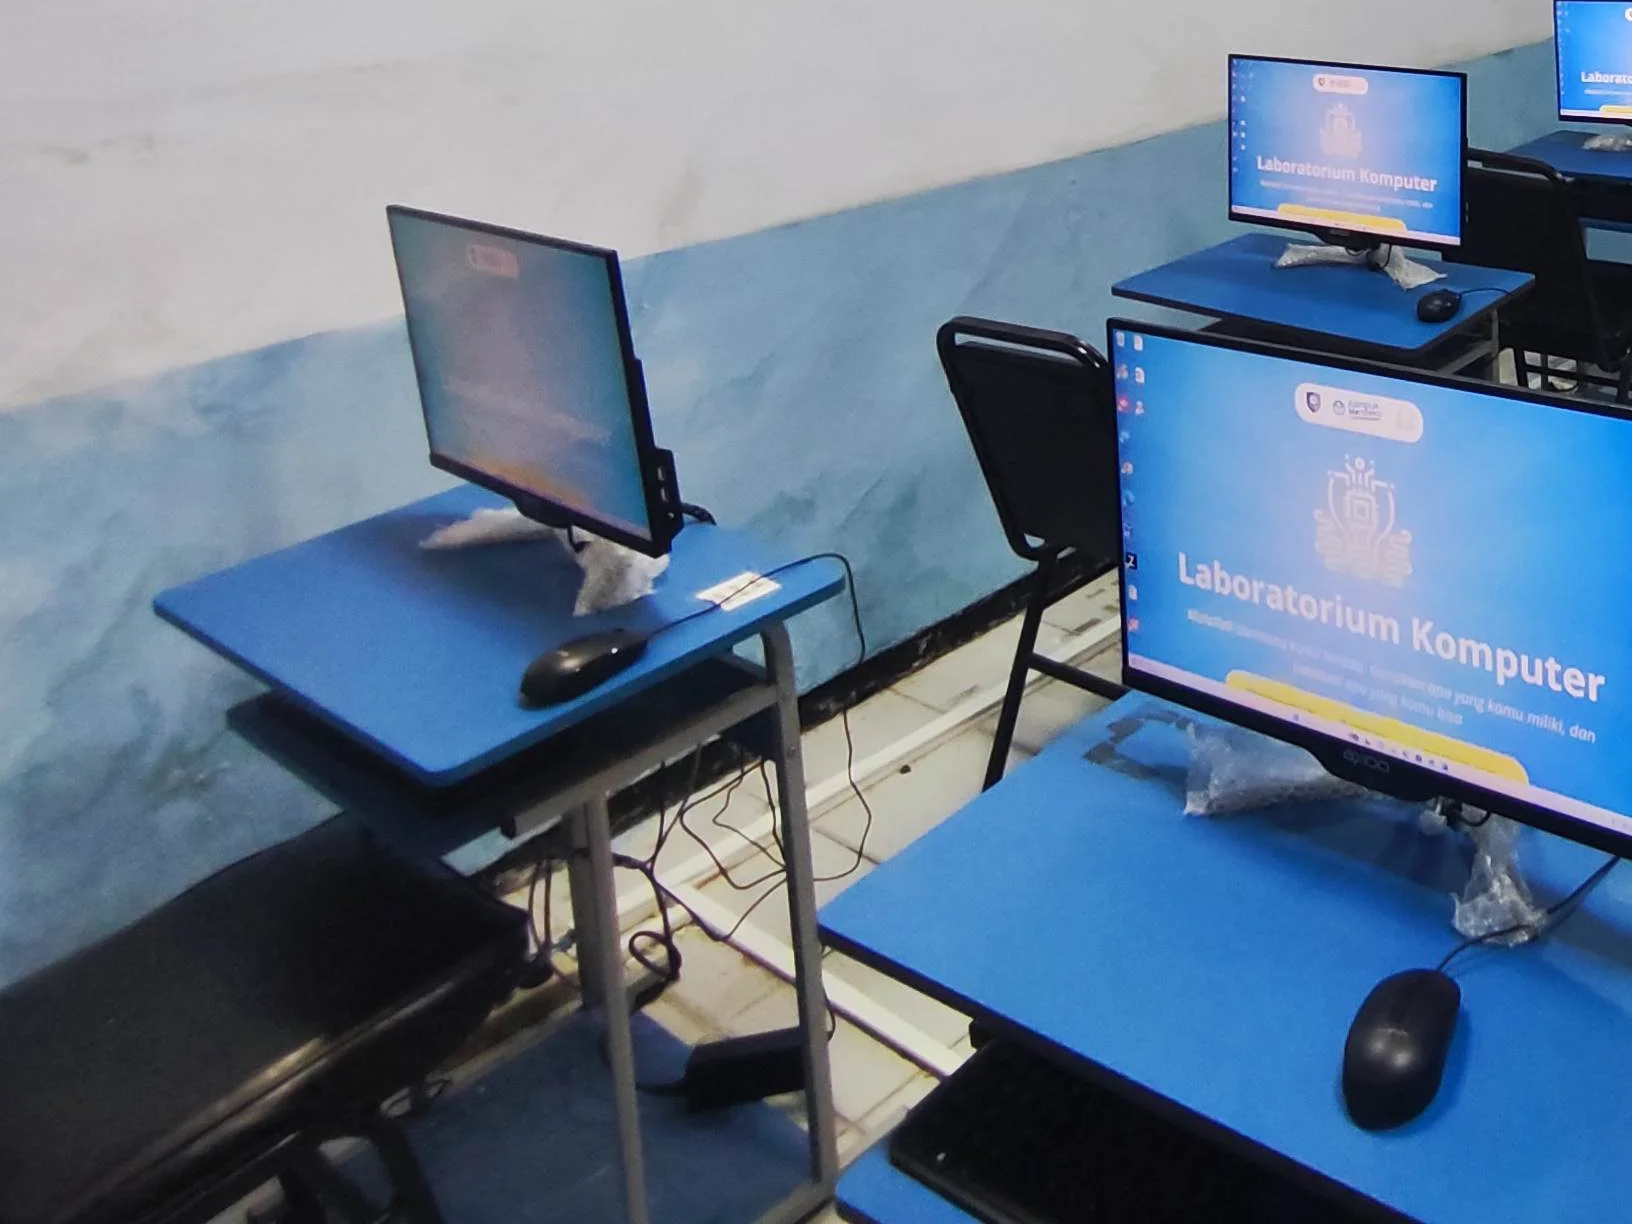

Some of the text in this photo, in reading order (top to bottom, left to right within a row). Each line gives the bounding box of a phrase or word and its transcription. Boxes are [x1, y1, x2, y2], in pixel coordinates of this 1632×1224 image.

[1256, 155, 1356, 181] Laboratorium
[1359, 167, 1438, 192] Komputer
[1177, 551, 1606, 702] Laboratorium Komputer
[1488, 698, 1524, 722] kamu
[1569, 724, 1596, 744] dan
